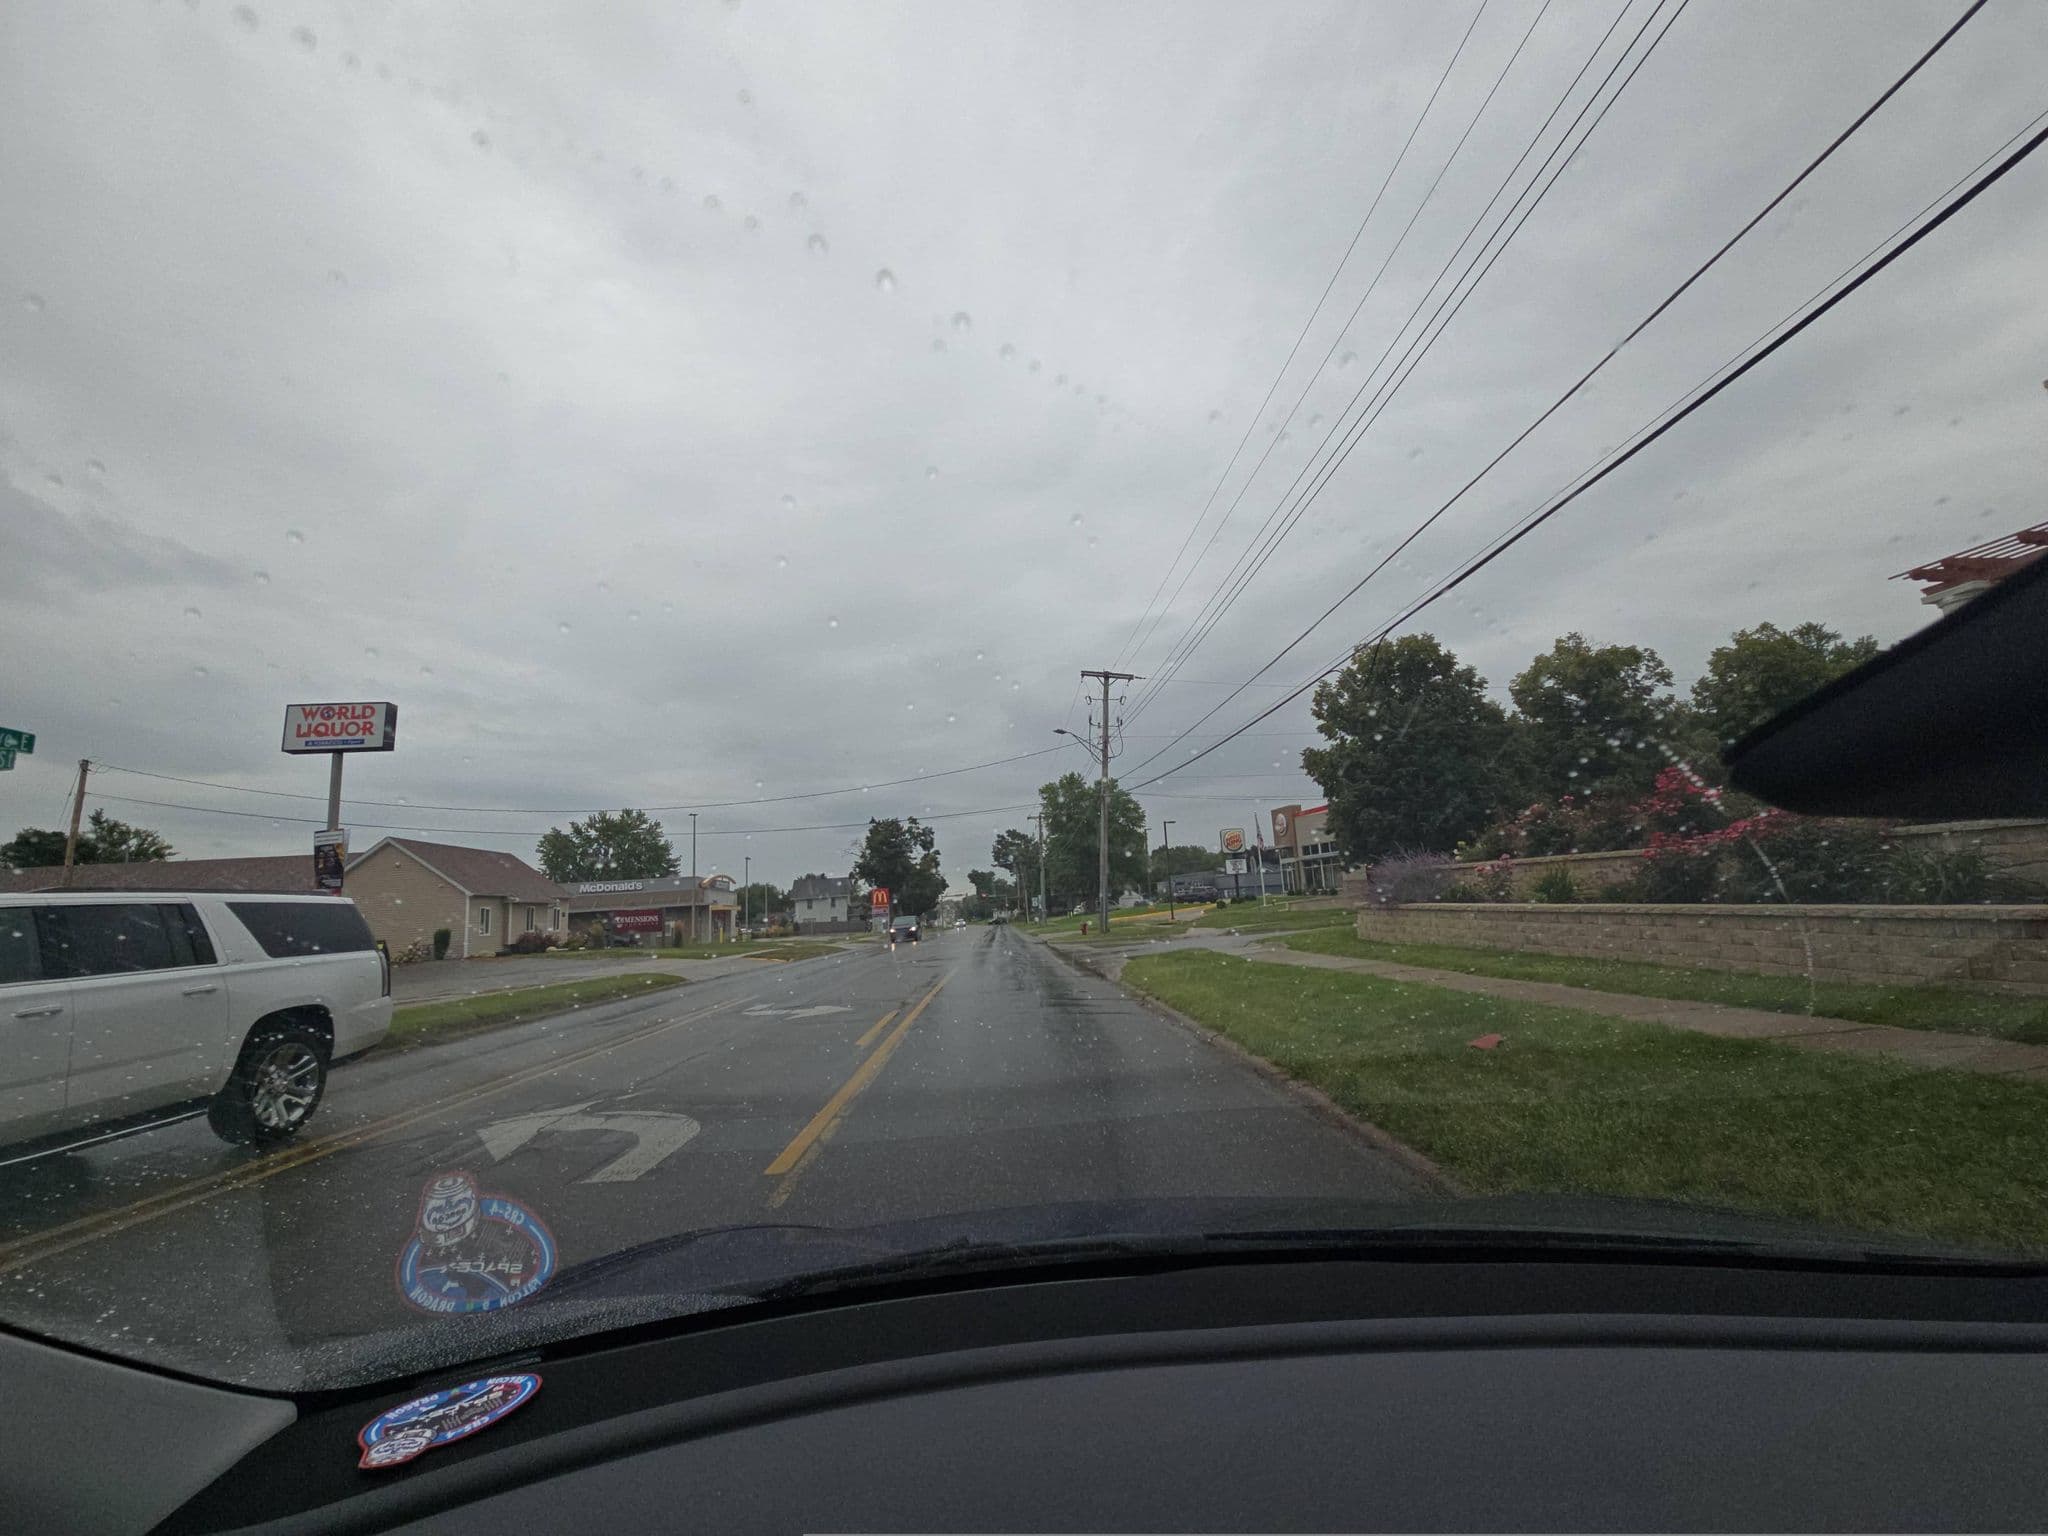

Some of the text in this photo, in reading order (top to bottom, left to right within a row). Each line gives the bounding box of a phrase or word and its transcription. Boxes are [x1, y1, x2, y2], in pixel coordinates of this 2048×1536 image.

[301, 705, 376, 721] WORLD
[296, 721, 375, 738] LIQUOR
[579, 881, 643, 894] McDonald's
